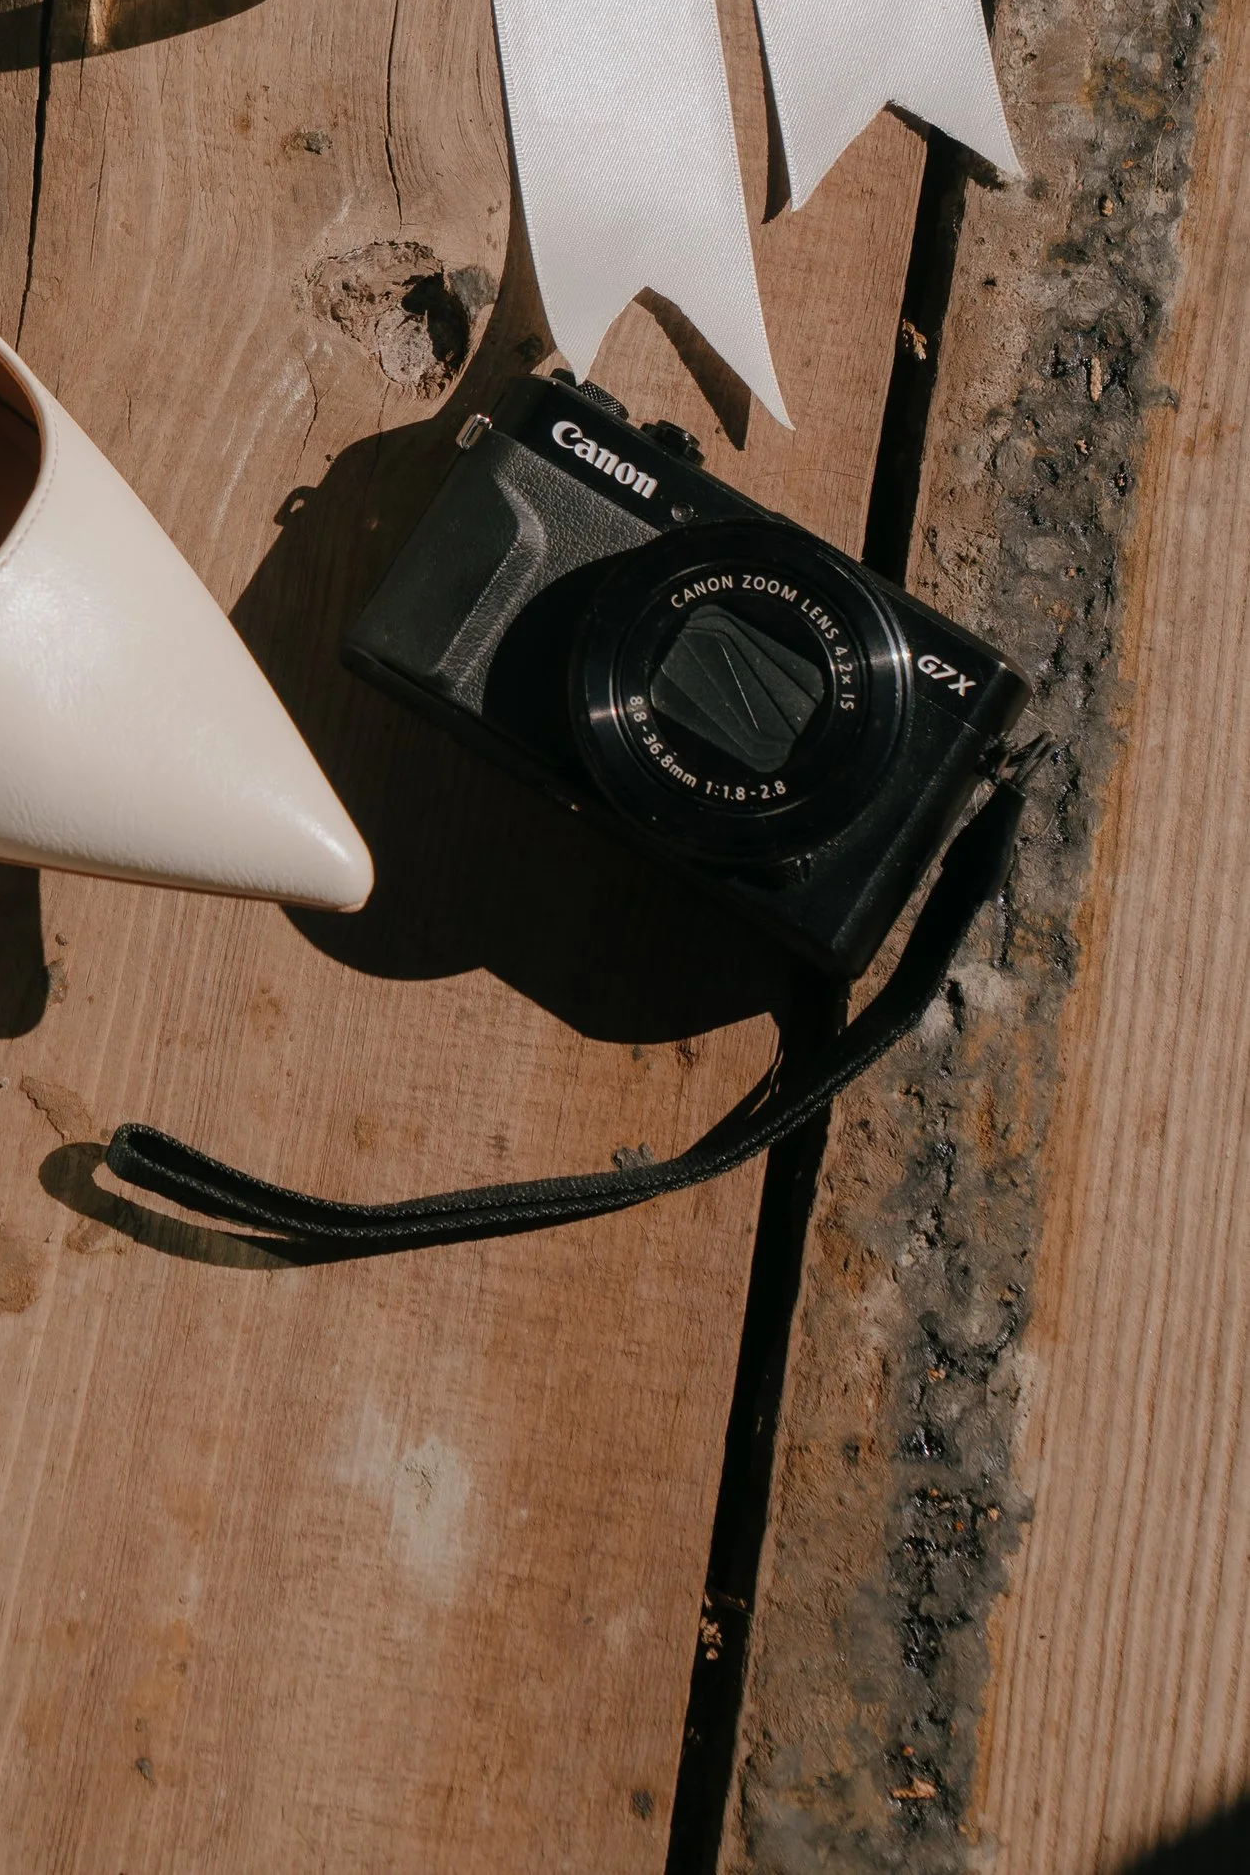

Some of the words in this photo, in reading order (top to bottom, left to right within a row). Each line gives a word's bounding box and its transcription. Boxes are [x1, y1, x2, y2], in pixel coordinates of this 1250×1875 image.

[552, 420, 658, 499] Canon
[670, 575, 734, 609] CANON
[742, 575, 798, 603] ZOOM
[800, 599, 840, 640] LENS
[840, 693, 855, 711] IS
